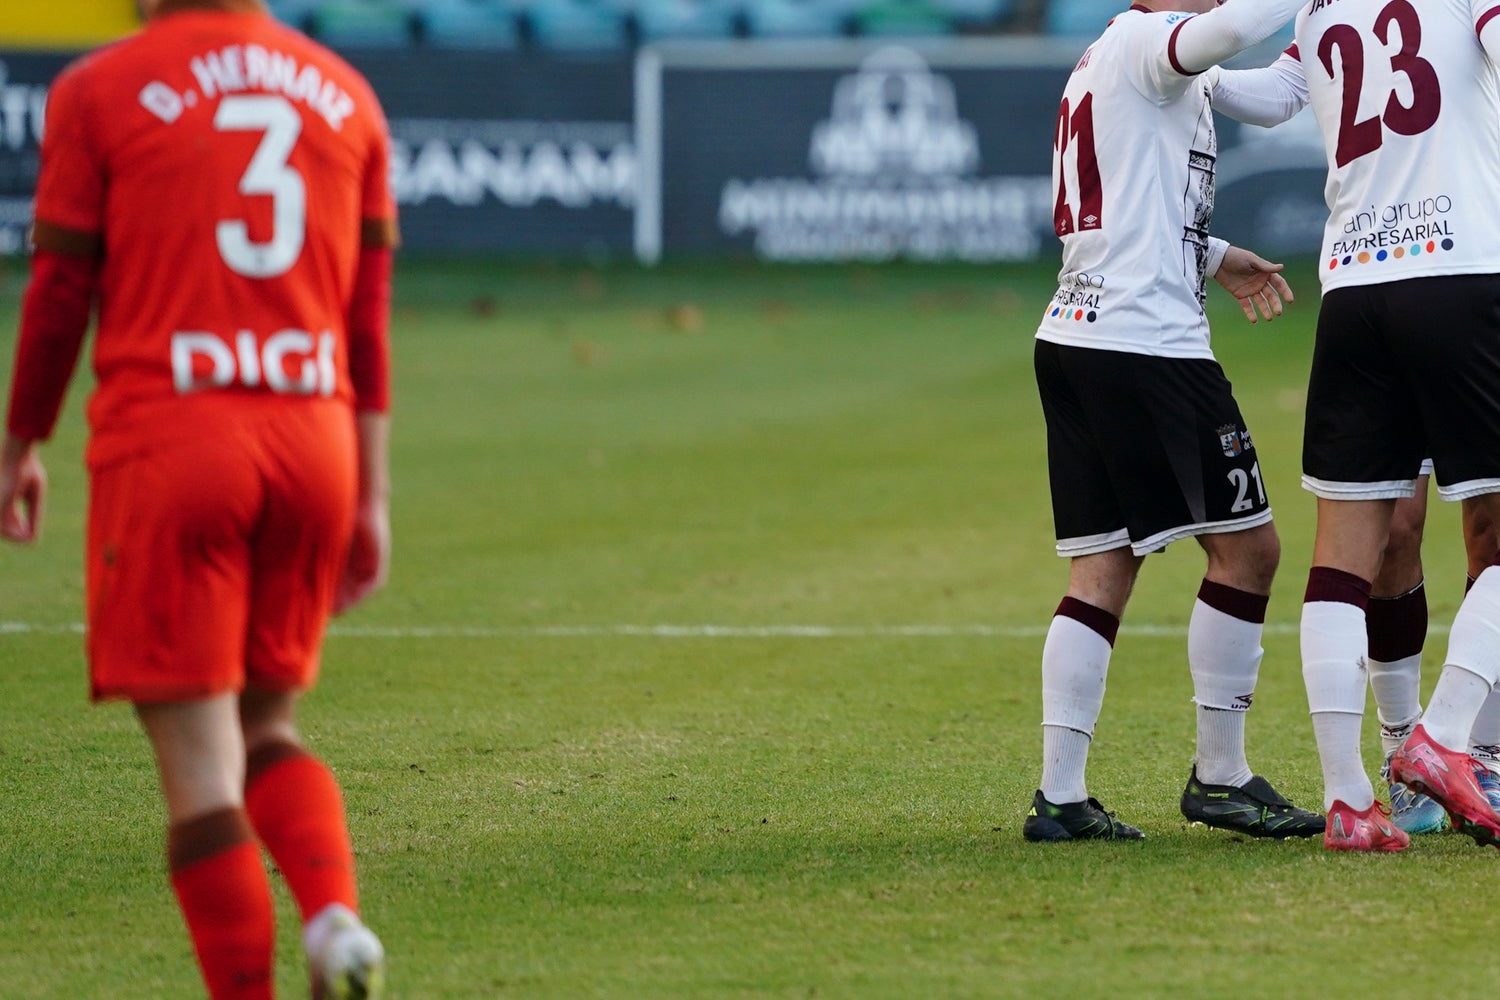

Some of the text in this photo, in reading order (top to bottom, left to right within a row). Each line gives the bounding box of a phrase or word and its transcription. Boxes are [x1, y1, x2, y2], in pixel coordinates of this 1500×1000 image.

[139, 80, 198, 125] D.
[213, 96, 306, 279] 3
[1382, 195, 1452, 230] grupo
[1331, 220, 1454, 257] EMPRESARIAL
[170, 330, 336, 398] DIGI
[1227, 461, 1266, 513] 21
